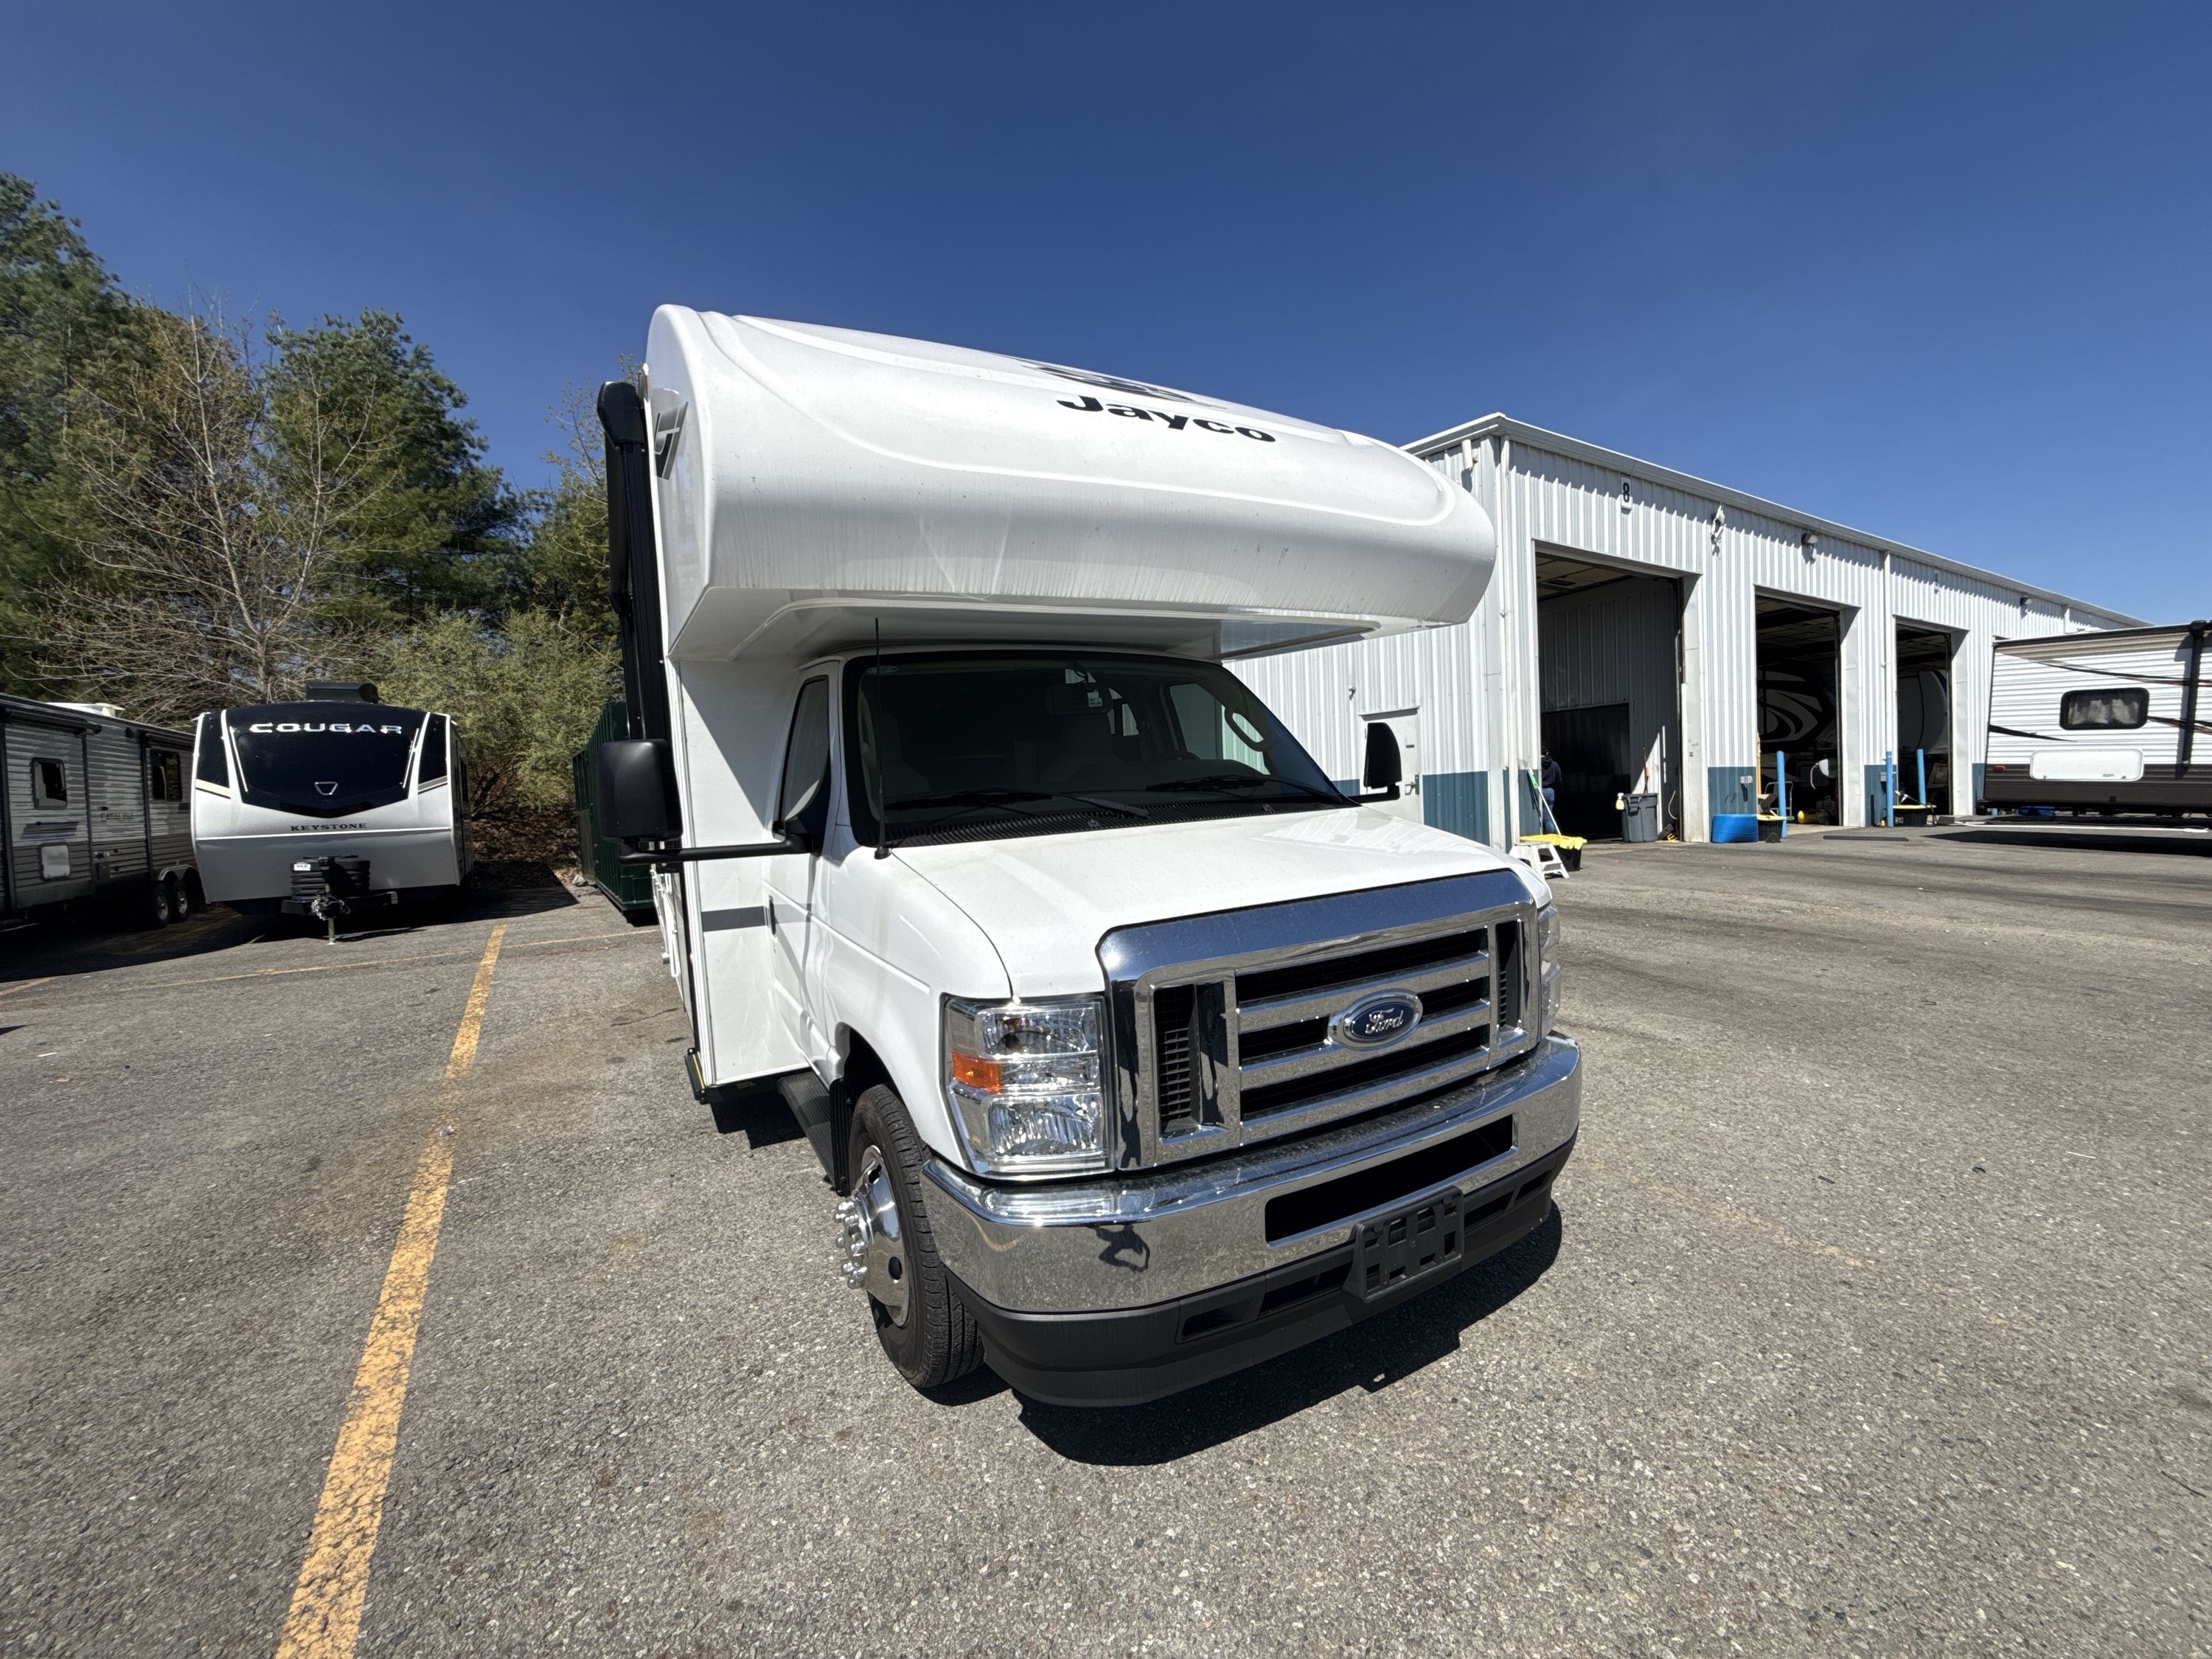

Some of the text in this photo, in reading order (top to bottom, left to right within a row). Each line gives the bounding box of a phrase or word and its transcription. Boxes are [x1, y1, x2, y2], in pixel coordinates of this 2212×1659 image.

[1056, 395, 1276, 442] Jayco
[1623, 482, 1630, 503] 8
[249, 723, 402, 734] COUGAR
[290, 823, 367, 831] KEYSTONE
[1365, 1007, 1404, 1034] Ford
